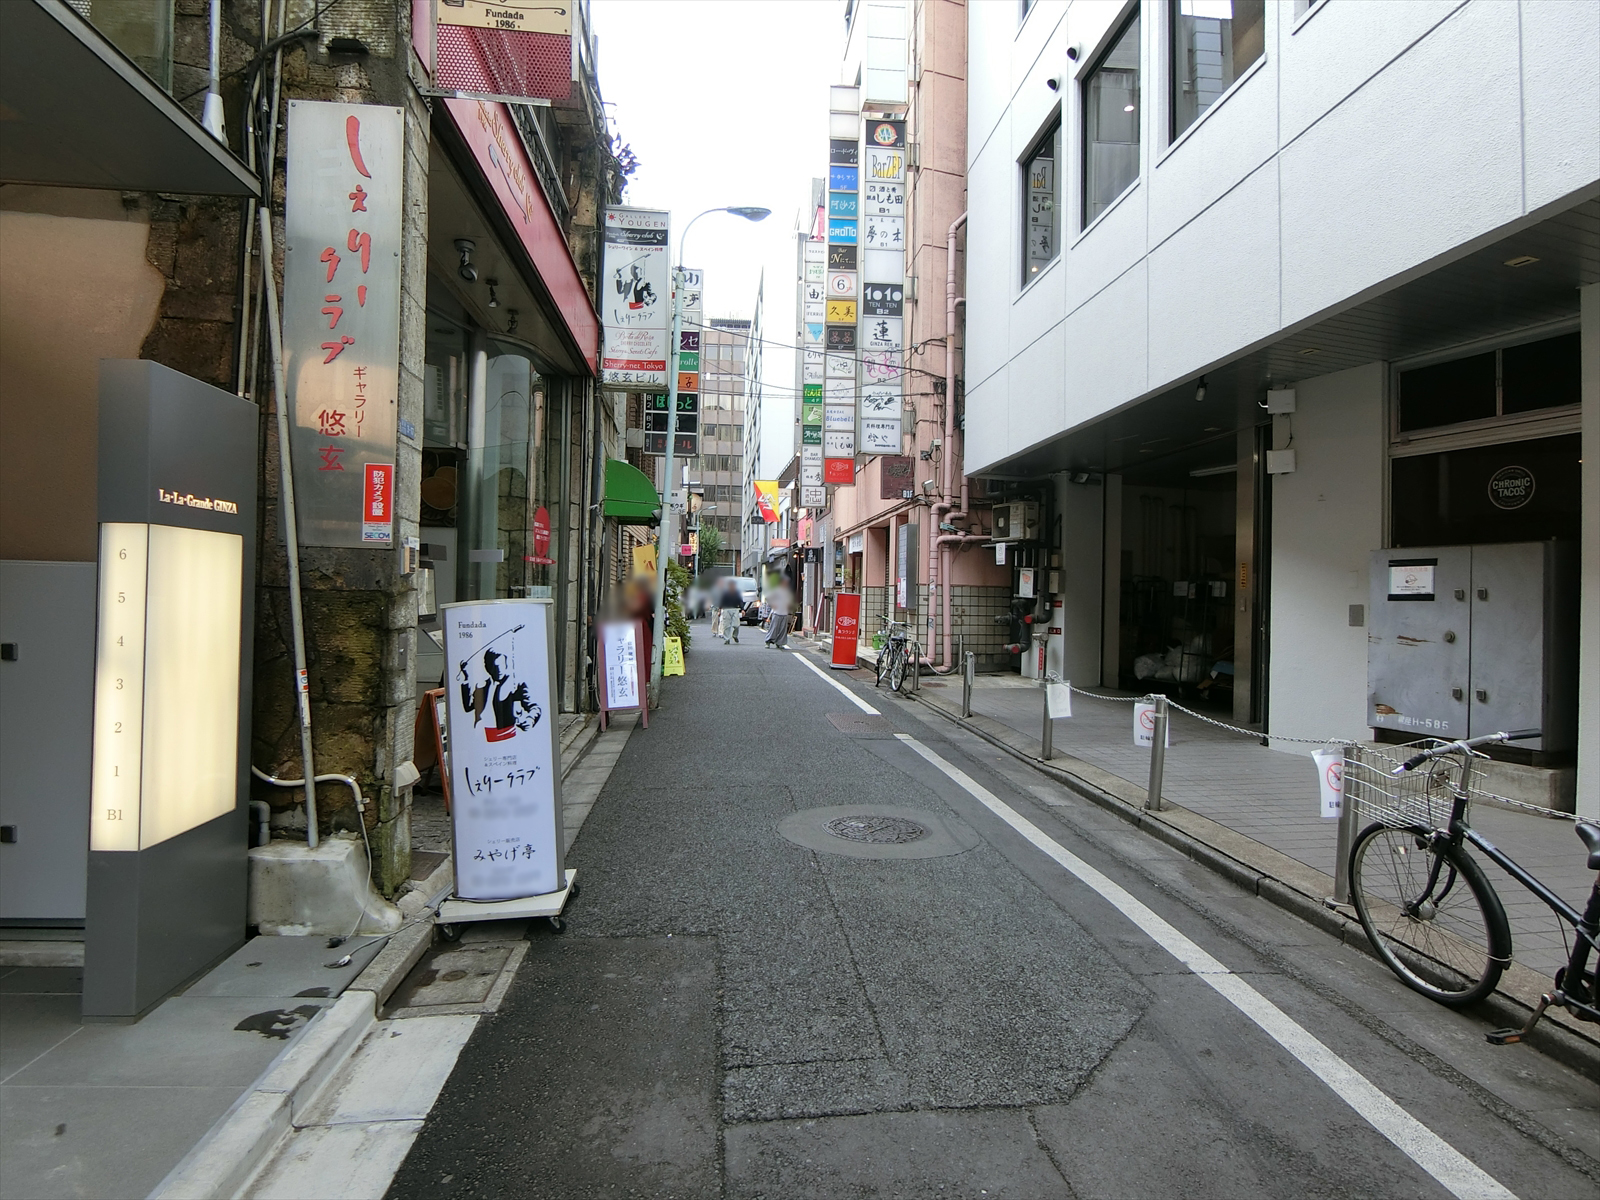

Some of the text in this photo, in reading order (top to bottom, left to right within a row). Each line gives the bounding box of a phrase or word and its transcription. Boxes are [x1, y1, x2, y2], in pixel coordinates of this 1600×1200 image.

[485, 8, 524, 22] Fundada
[495, 19, 516, 32] 1986
[618, 218, 666, 228] YOUGEN
[829, 226, 857, 237] GROTTO
[641, 362, 664, 370] Tokyo
[608, 371, 660, 384] 悠玄ビル
[354, 366, 368, 438] ギャラリー
[318, 409, 348, 472] 悠玄
[1492, 477, 1531, 490] CHRONIC
[1497, 486, 1525, 498] TACOS
[213, 498, 239, 515] GINZA
[118, 548, 128, 561] 6
[117, 591, 127, 604] 5
[458, 621, 488, 629] Fundada
[116, 635, 125, 648] 4
[458, 631, 475, 639] 1986
[115, 677, 125, 691] 3
[114, 720, 123, 734] 2
[483, 754, 518, 762] シェリー専門店
[113, 765, 120, 778] 1
[106, 808, 124, 821] B1
